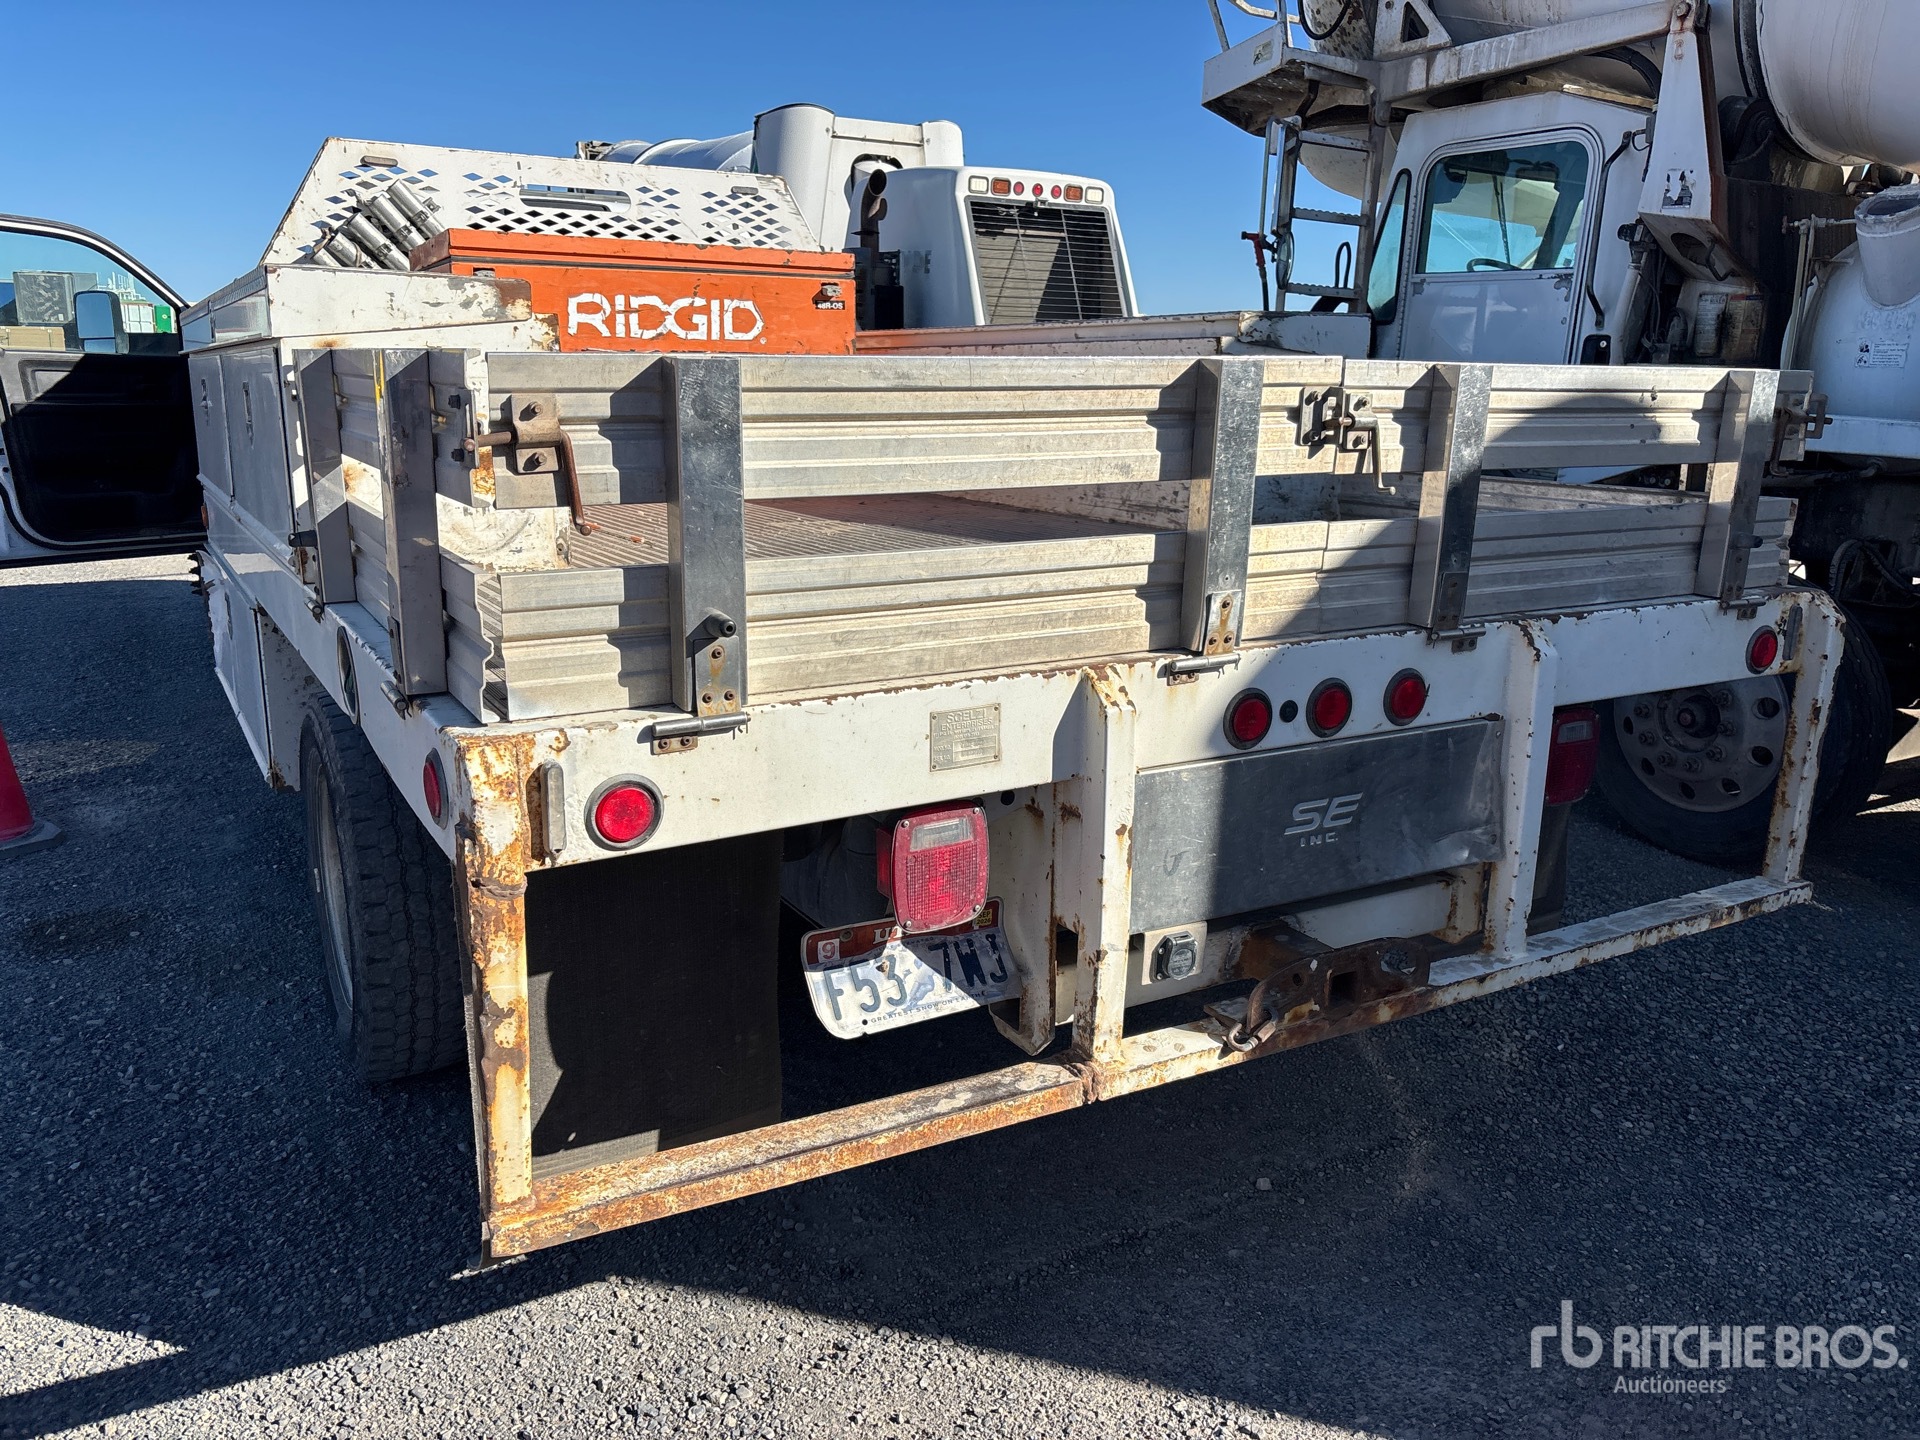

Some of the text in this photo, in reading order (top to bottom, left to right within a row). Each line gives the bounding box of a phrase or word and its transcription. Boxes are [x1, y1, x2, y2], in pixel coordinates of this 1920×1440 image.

[567, 293, 765, 341] RIDGID
[941, 718, 993, 731] ENTERPRISES
[1284, 792, 1363, 835] SE
[978, 911, 991, 919] SEP
[873, 925, 903, 944] UT
[822, 942, 836, 960] 9
[823, 953, 908, 1021] F53
[870, 1009, 913, 1024] GREATEST
[916, 1002, 939, 1012] SNOW
